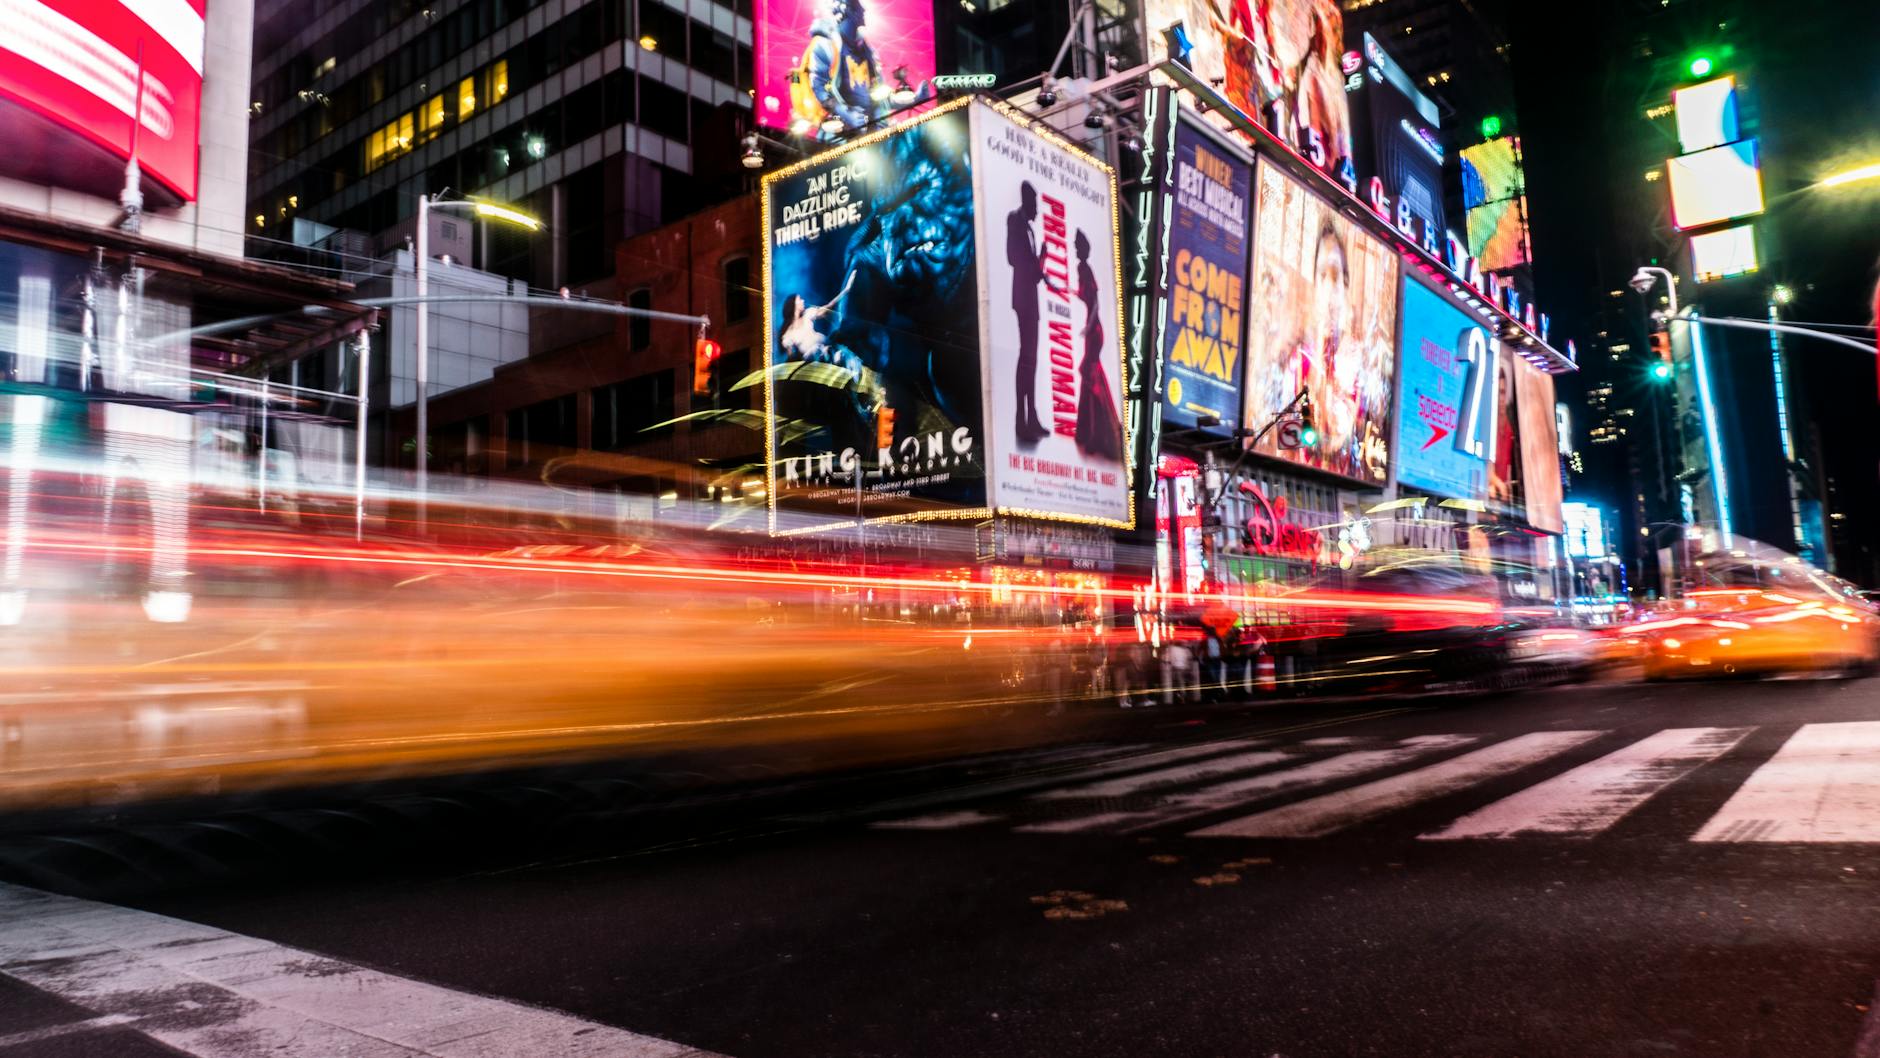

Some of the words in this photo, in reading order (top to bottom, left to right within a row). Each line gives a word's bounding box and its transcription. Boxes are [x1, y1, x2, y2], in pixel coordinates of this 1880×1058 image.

[831, 161, 868, 188] EPIC
[1179, 161, 1204, 200] BEST
[775, 217, 820, 248] THRILL
[783, 186, 850, 224] DAZZLING
[1042, 192, 1070, 304] PRETTY
[1176, 248, 1241, 312] COME
[1173, 283, 1240, 347] FROM
[1048, 320, 1077, 438] WOMAN
[1170, 326, 1239, 383] AWAY
[1458, 326, 1501, 464] 21
[785, 447, 856, 482] KING
[879, 426, 973, 467] KONG
[785, 476, 830, 489] ALIVE
